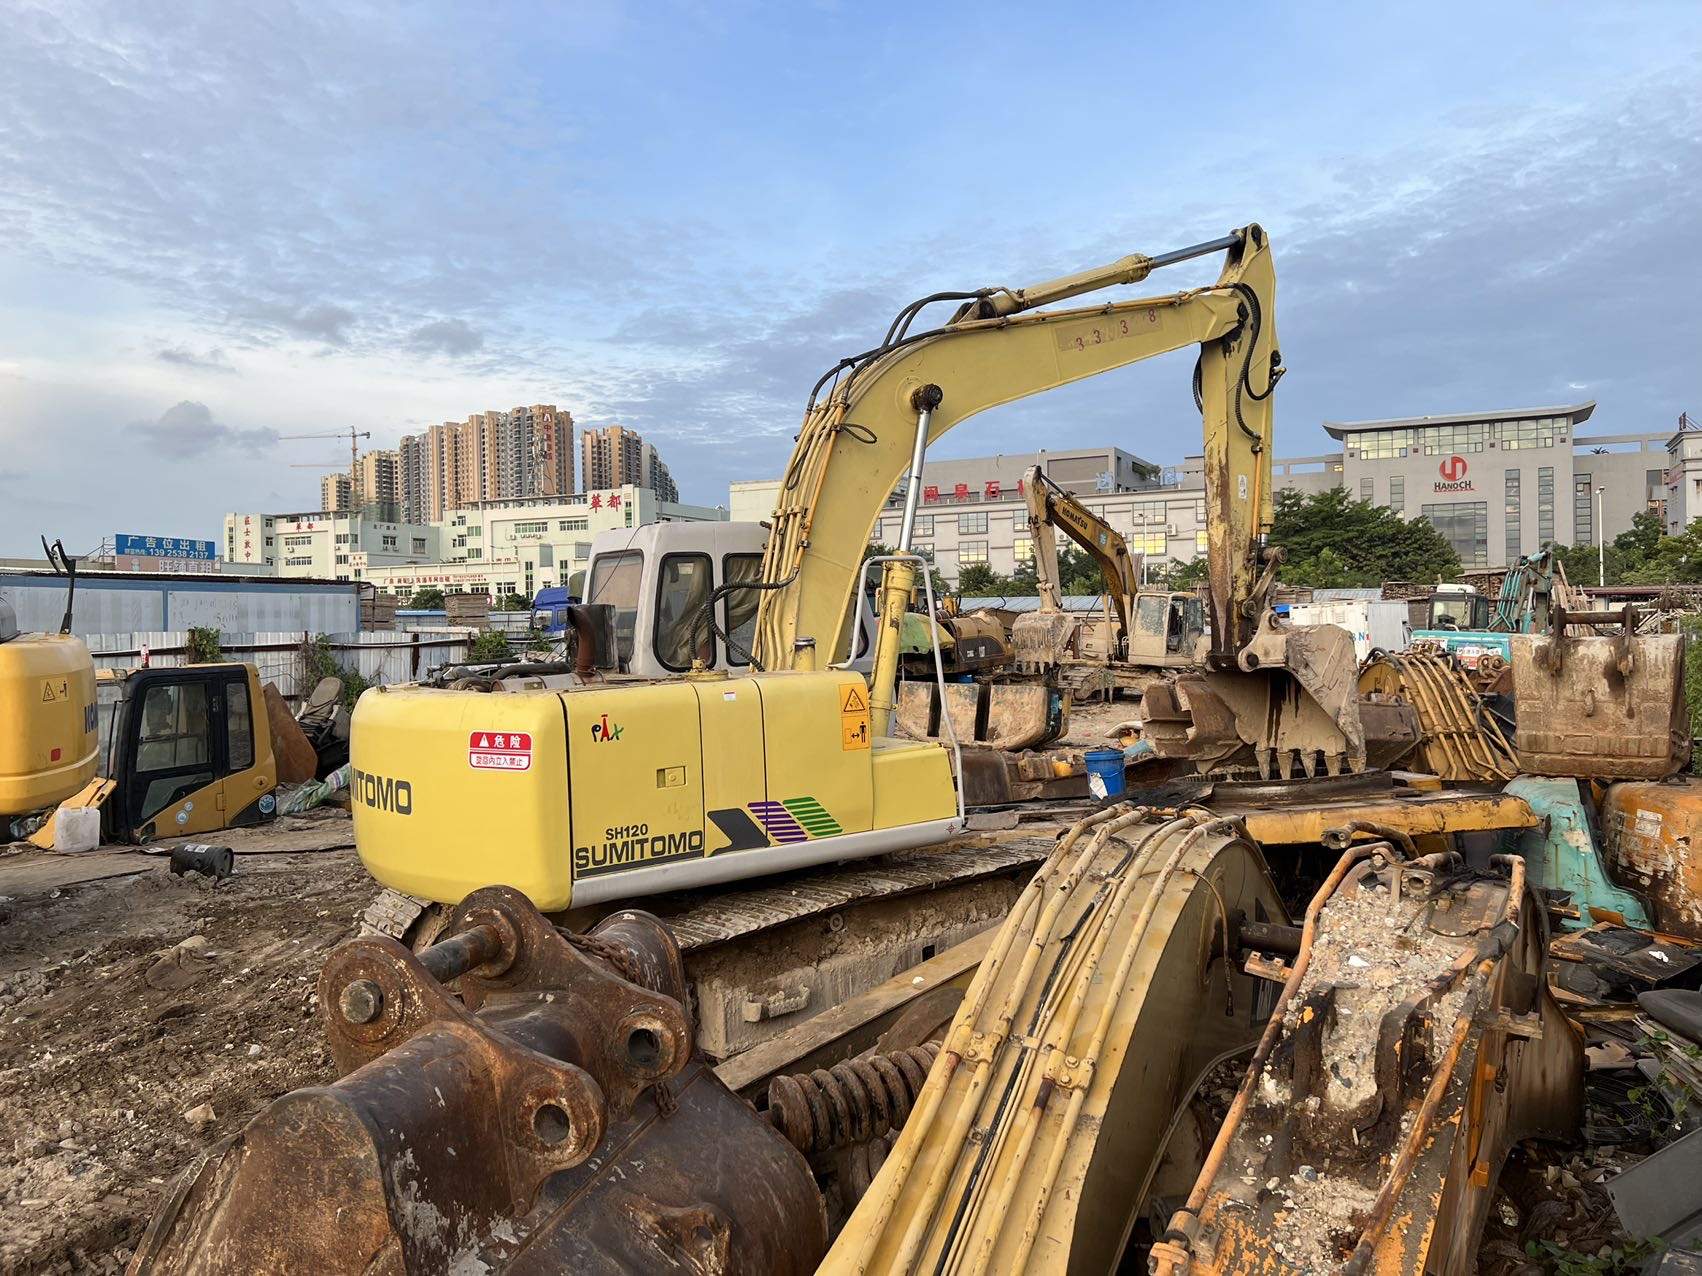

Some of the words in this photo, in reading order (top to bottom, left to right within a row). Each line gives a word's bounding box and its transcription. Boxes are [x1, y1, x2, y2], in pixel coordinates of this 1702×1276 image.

[1434, 481, 1472, 491] HANOCH
[1062, 506, 1088, 530] KOMATSU
[128, 536, 206, 551] 广告位出租
[149, 549, 165, 557] 139
[167, 549, 187, 558] 2538
[189, 550, 208, 559] 2137
[605, 823, 648, 841] SH120
[575, 830, 703, 869] SUMITOMO
